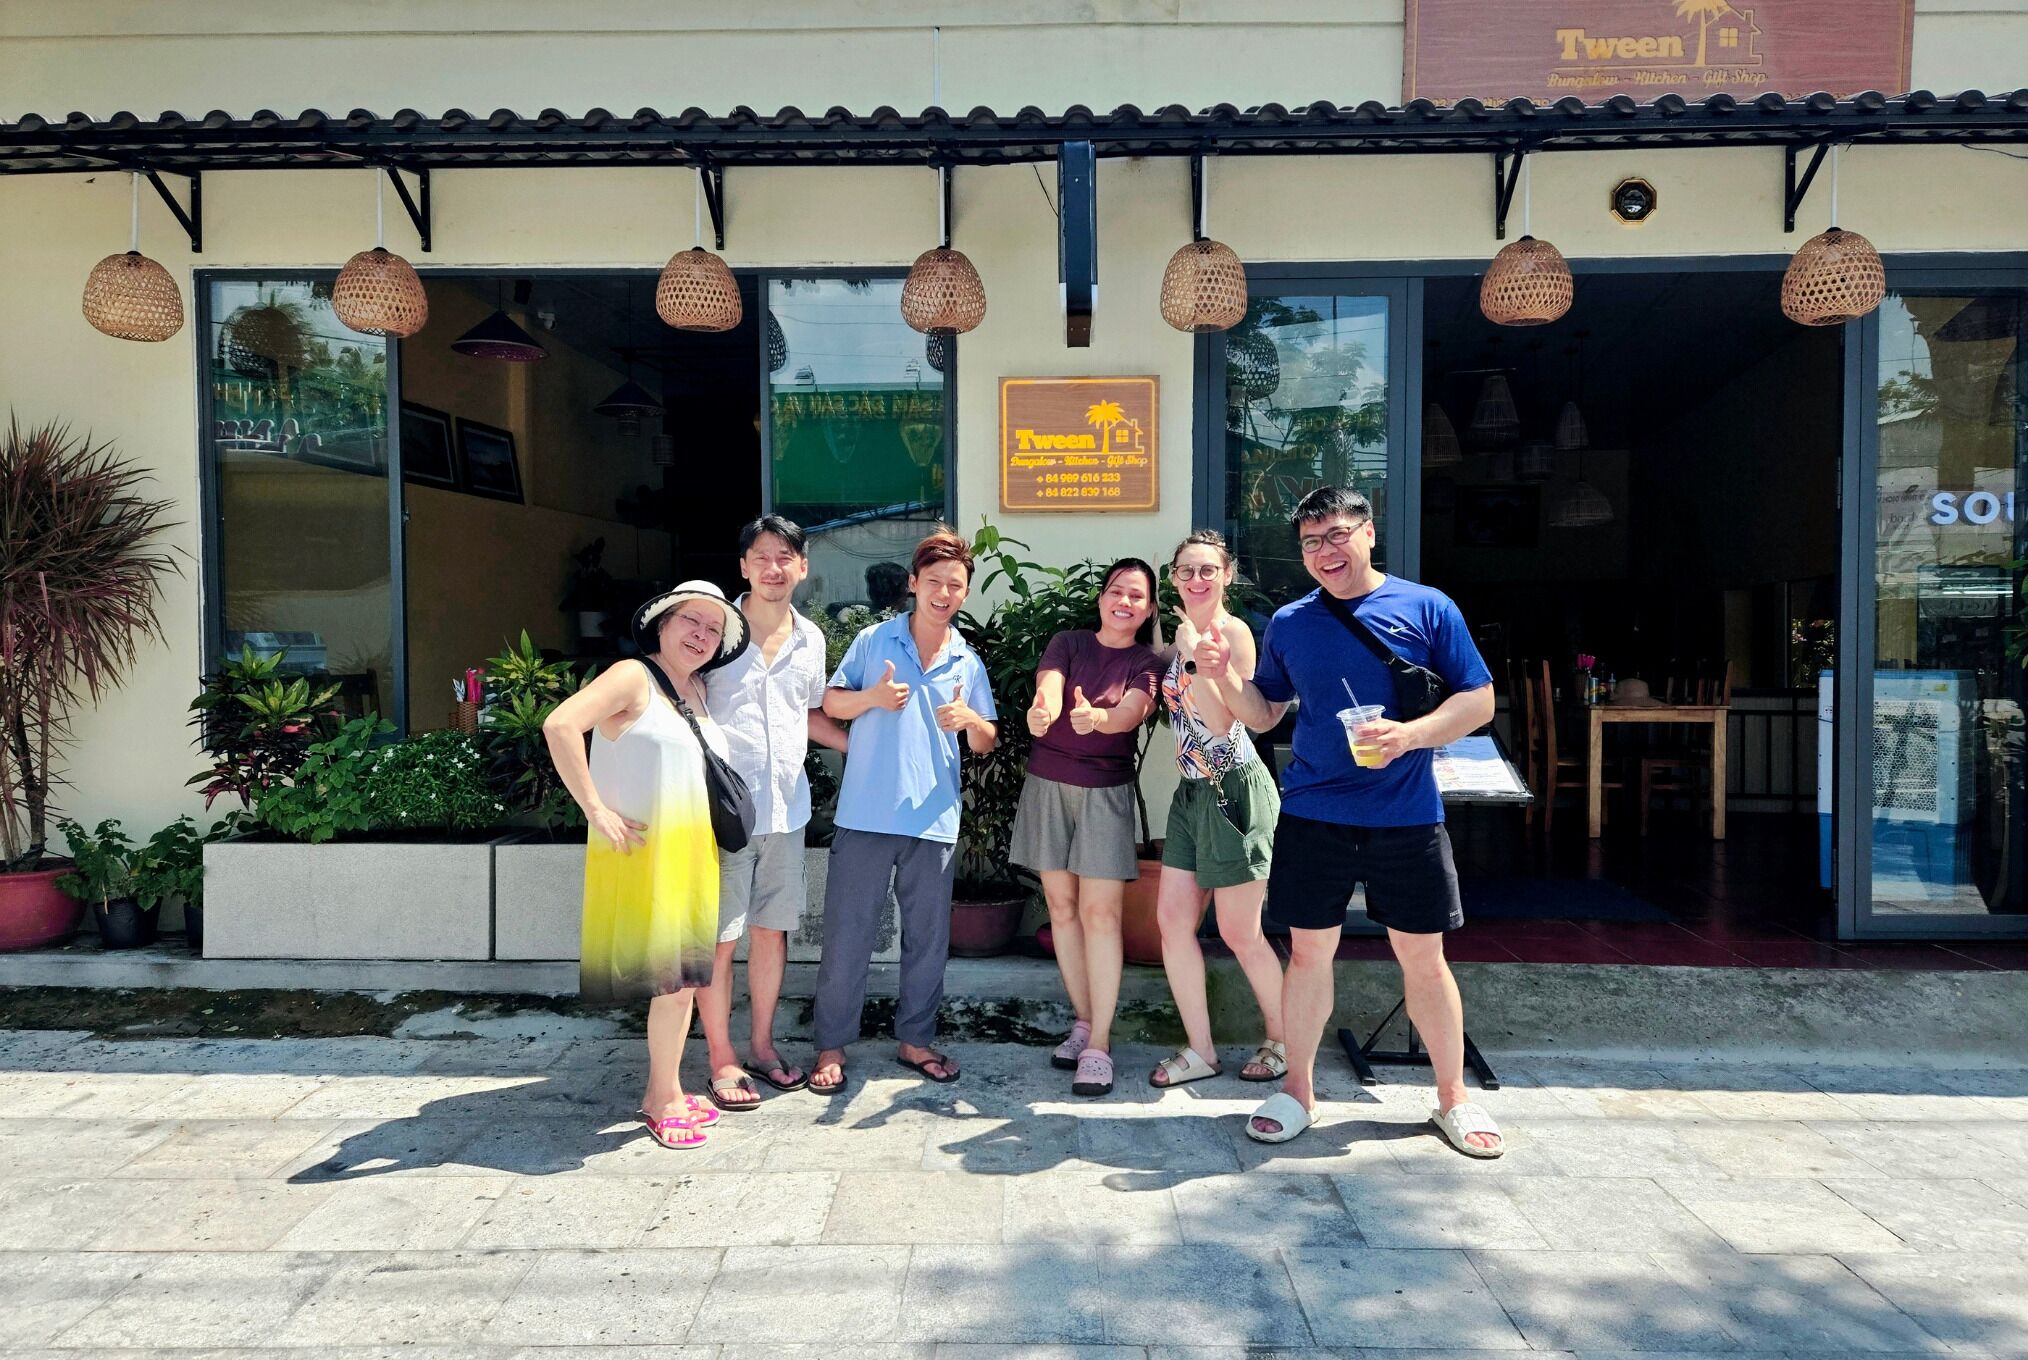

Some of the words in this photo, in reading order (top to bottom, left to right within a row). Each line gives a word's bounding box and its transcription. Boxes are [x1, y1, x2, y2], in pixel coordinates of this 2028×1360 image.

[1557, 28, 1684, 60] Tween
[1547, 71, 1618, 90] Bungalow
[1634, 70, 1687, 86] Kitchen
[1703, 69, 1728, 88] Gift
[1732, 68, 1766, 88] Shop
[1016, 430, 1096, 450] Tween
[1011, 456, 1056, 469] Bungalow
[1064, 456, 1099, 465] Kitchen
[1107, 455, 1124, 468] Gift
[1125, 455, 1148, 467] Shop
[1060, 473, 1079, 483] 989
[1081, 473, 1100, 483] 616
[1102, 473, 1120, 482] 233
[1060, 487, 1079, 497] 822
[1081, 487, 1100, 497] 839
[1102, 487, 1120, 496] 168
